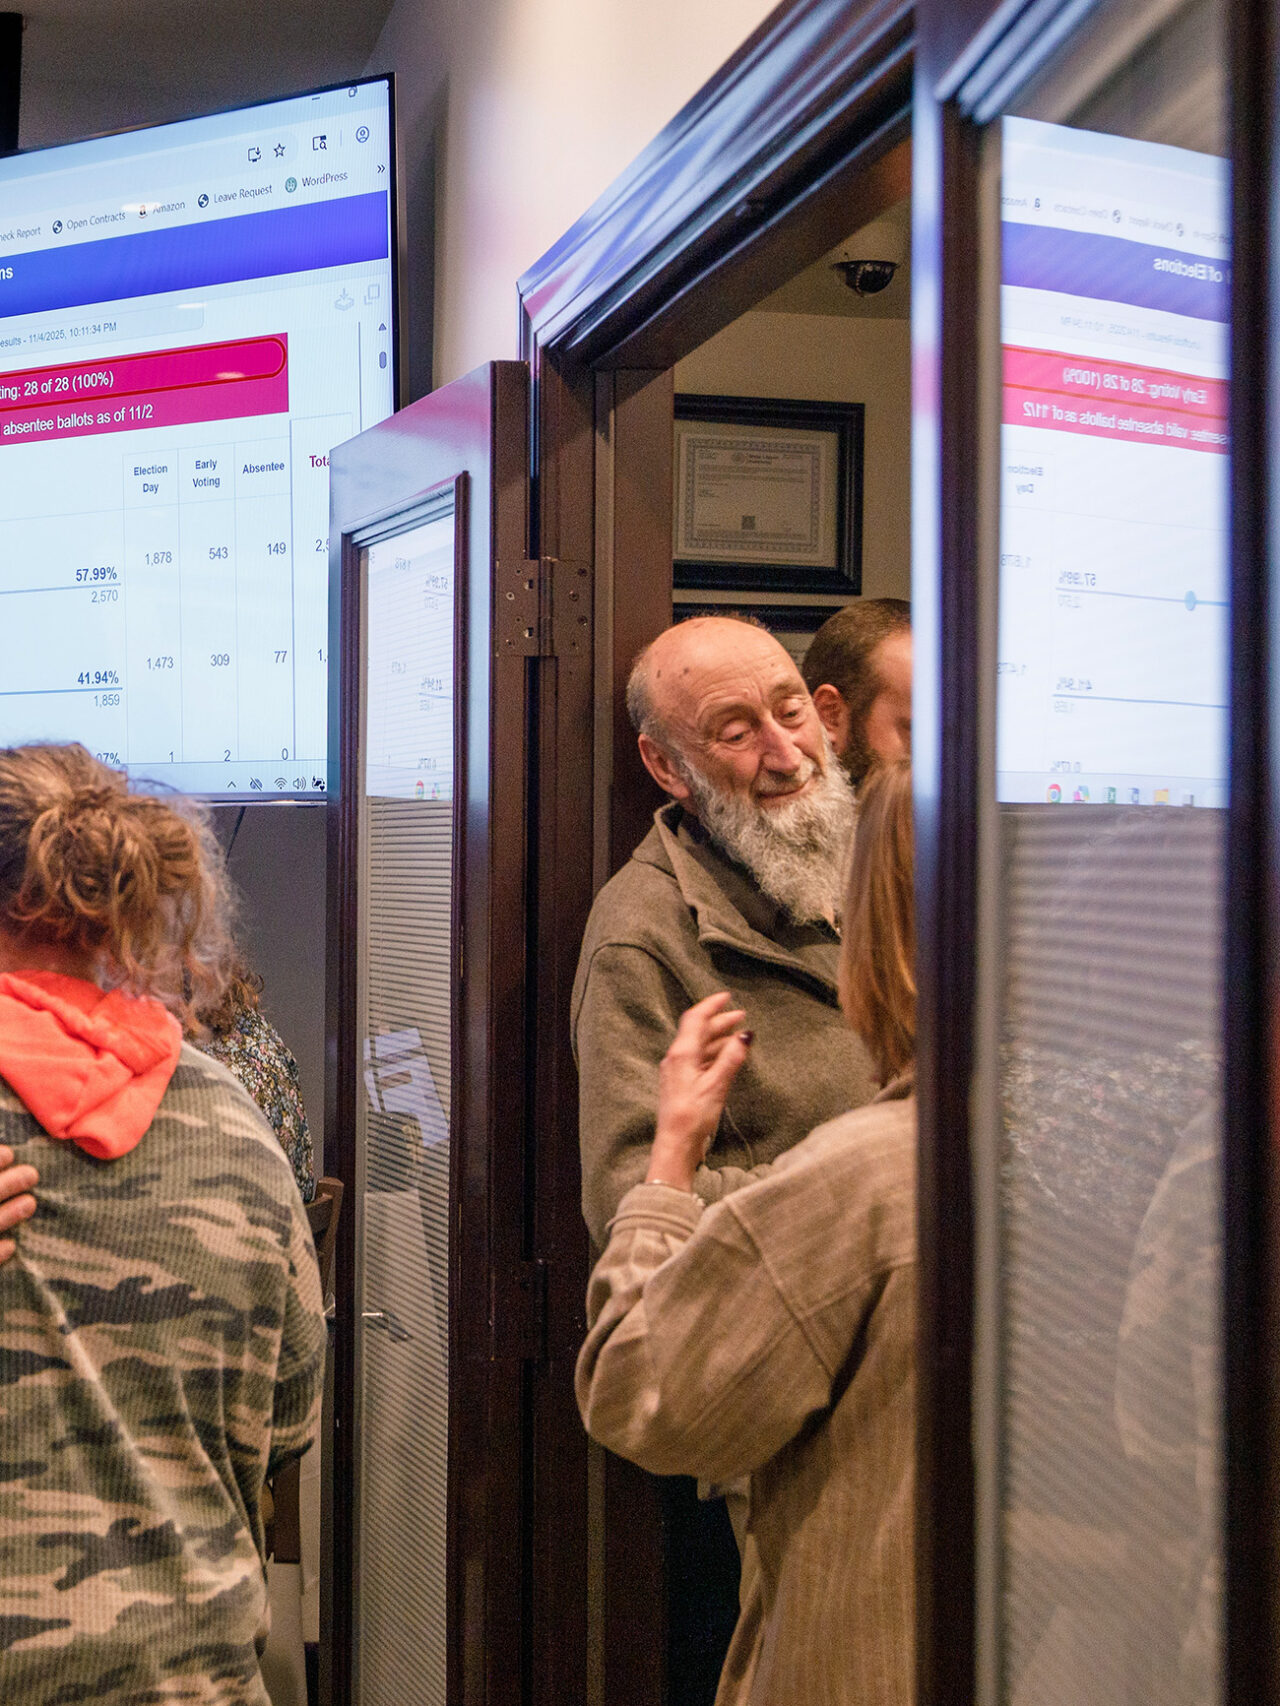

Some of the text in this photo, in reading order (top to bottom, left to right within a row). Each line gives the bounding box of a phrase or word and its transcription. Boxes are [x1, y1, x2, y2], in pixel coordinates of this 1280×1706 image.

[302, 171, 348, 188] WordPress
[214, 185, 273, 203] Leave Request
[153, 200, 185, 214] Amazon
[66, 211, 126, 231] Open Contracts
[16, 227, 41, 239] Report
[29, 329, 67, 344] 11/4/2025,
[70, 325, 101, 337] 10:11:34
[103, 322, 117, 332] PM
[24, 382, 38, 396] 28
[41, 379, 53, 394] of
[55, 377, 69, 392] 28
[72, 371, 114, 392] (100%)
[3, 418, 54, 435] absentee
[57, 412, 94, 429] ballots
[97, 413, 111, 424] as
[114, 408, 126, 422] of
[128, 404, 154, 421] 11/2
[133, 463, 168, 476] Election
[195, 459, 217, 471] Early
[242, 462, 285, 475] Absentee
[142, 482, 159, 494] Day
[193, 476, 221, 488] Voting
[209, 547, 228, 559] 543
[267, 542, 286, 555] 149
[145, 551, 172, 566] 1,878
[75, 566, 118, 582] 57.99%
[91, 590, 118, 603] 2,570
[147, 657, 174, 670] 1,473
[210, 654, 230, 666] 309
[274, 651, 287, 663] 77
[77, 671, 119, 685] 41.94%
[94, 693, 120, 707] 1,859
[224, 749, 231, 761] 2
[281, 748, 288, 760] 0
